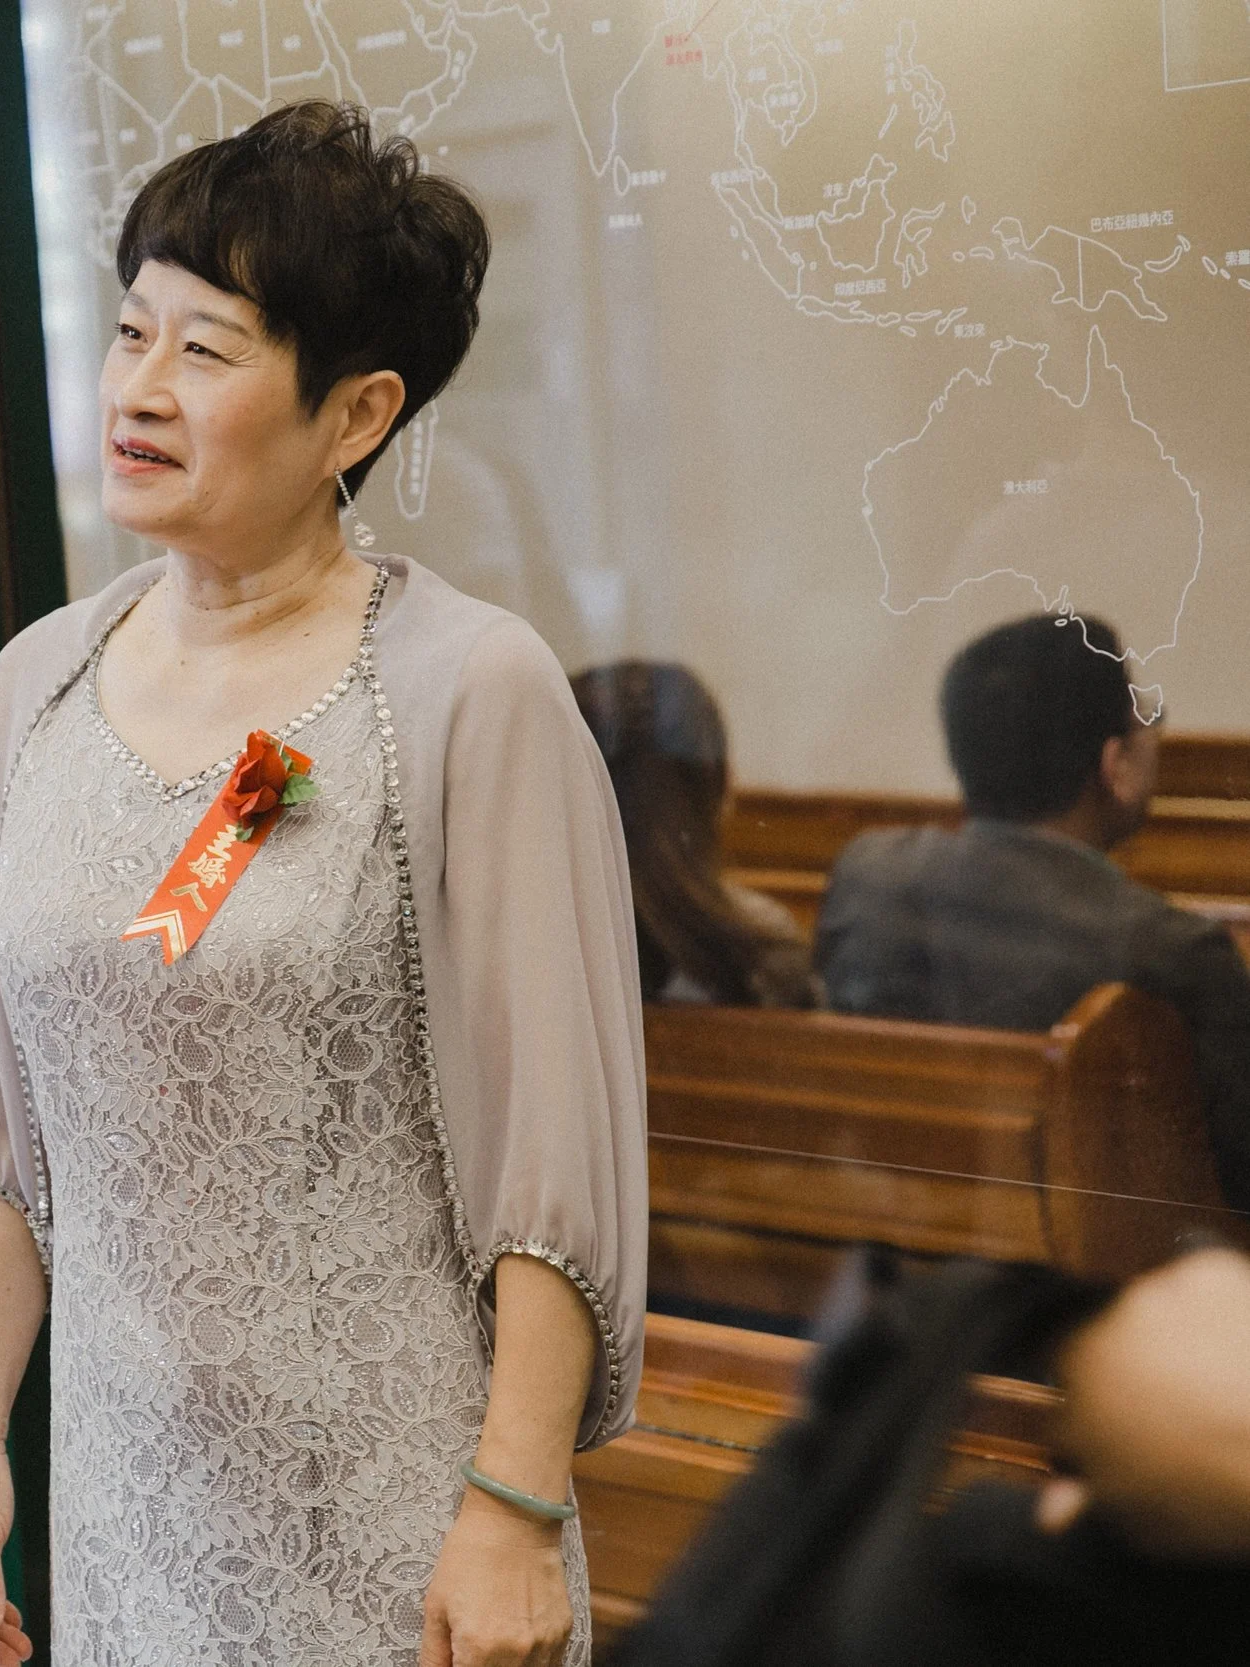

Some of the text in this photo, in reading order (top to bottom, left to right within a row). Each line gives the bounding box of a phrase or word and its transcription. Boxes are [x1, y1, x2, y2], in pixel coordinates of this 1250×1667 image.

[1090, 210, 1174, 232] 巴布亞紐幾內亞
[1003, 480, 1049, 496] 澳大利亞
[170, 824, 238, 912] 主婚人
